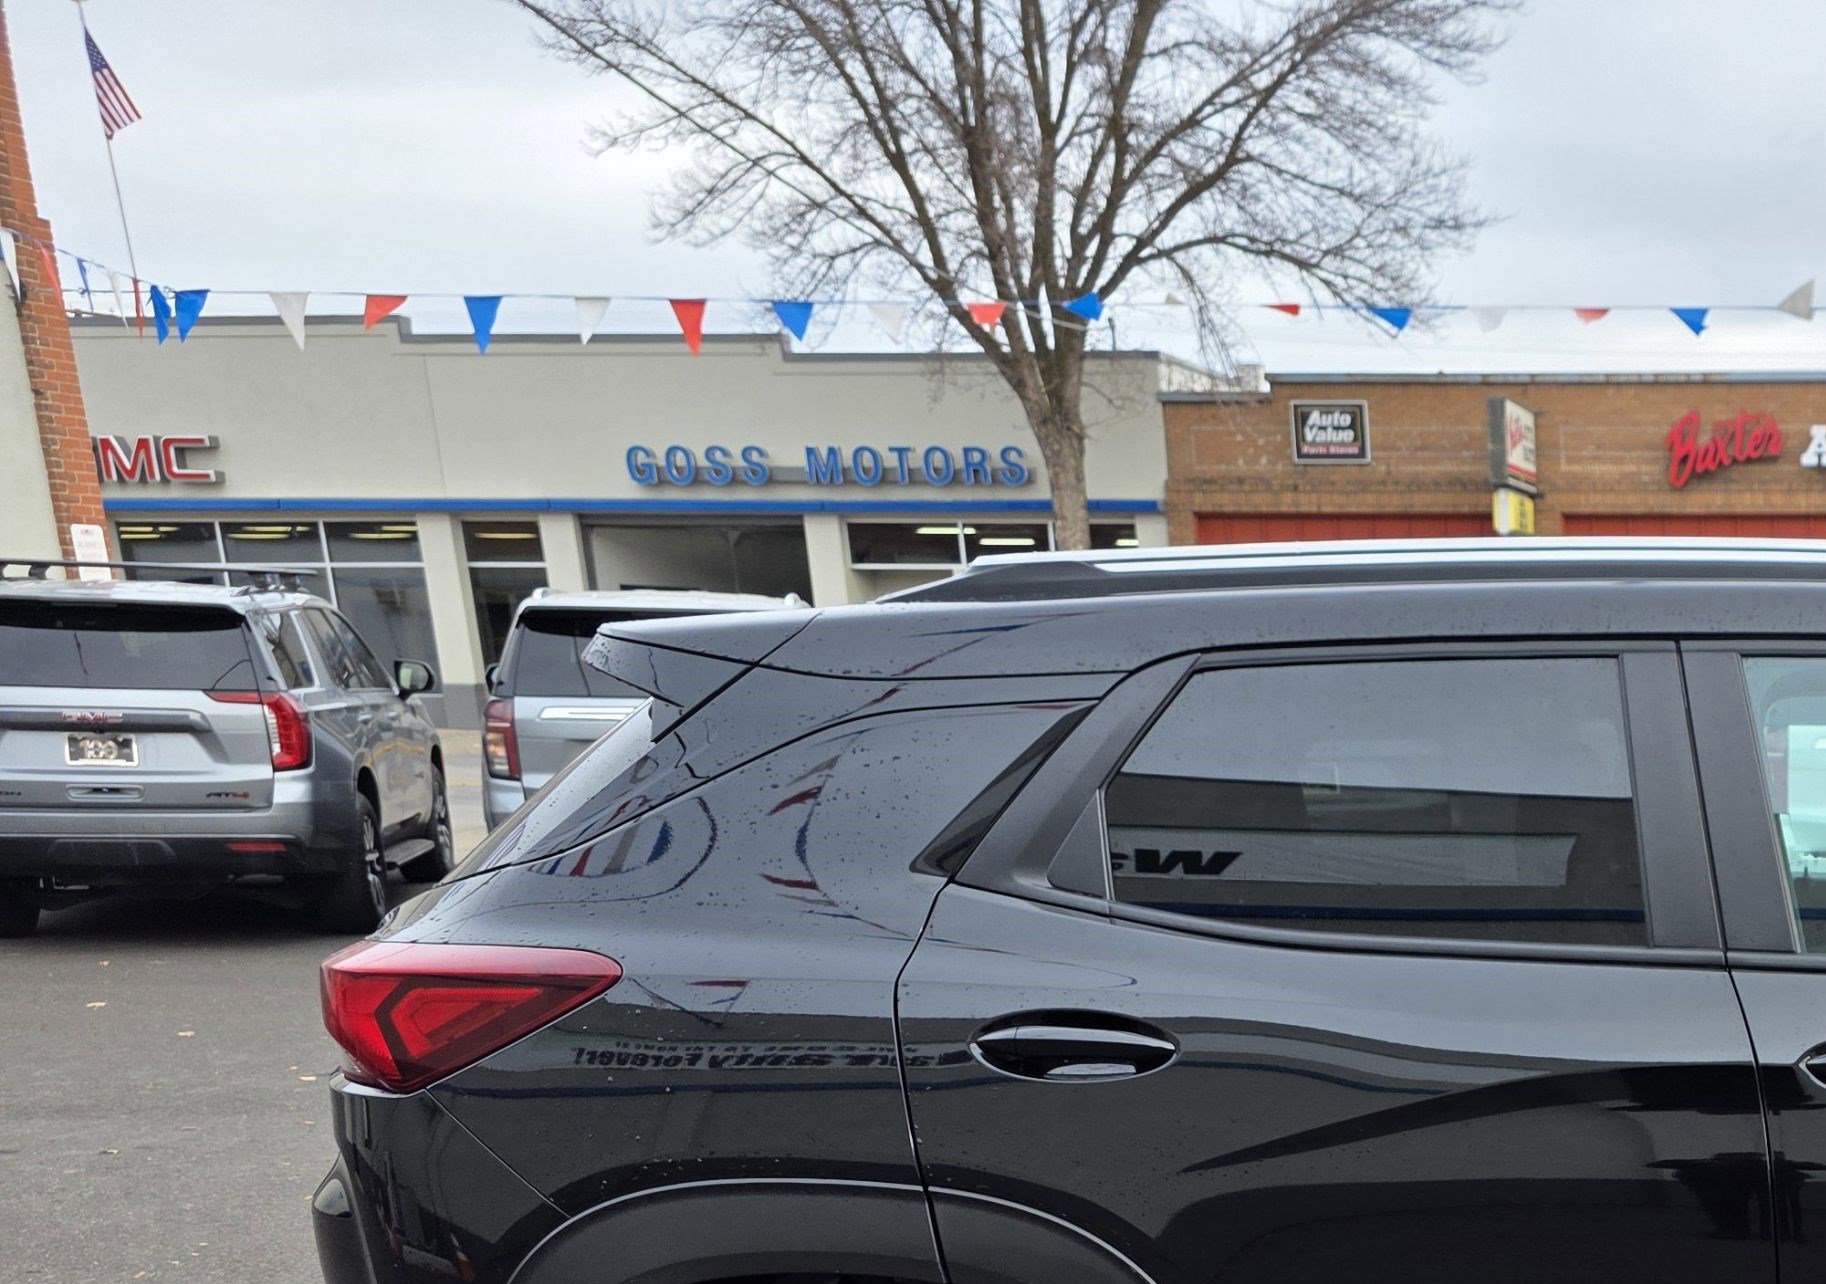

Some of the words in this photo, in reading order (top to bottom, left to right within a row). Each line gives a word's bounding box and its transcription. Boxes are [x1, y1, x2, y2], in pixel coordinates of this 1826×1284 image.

[1303, 426, 1355, 444] Value
[1306, 409, 1352, 428] Auto
[93, 435, 225, 484] MC
[625, 444, 772, 488] GOSS
[804, 444, 1031, 488] MOTORS
[1664, 409, 1784, 490] Baxter
